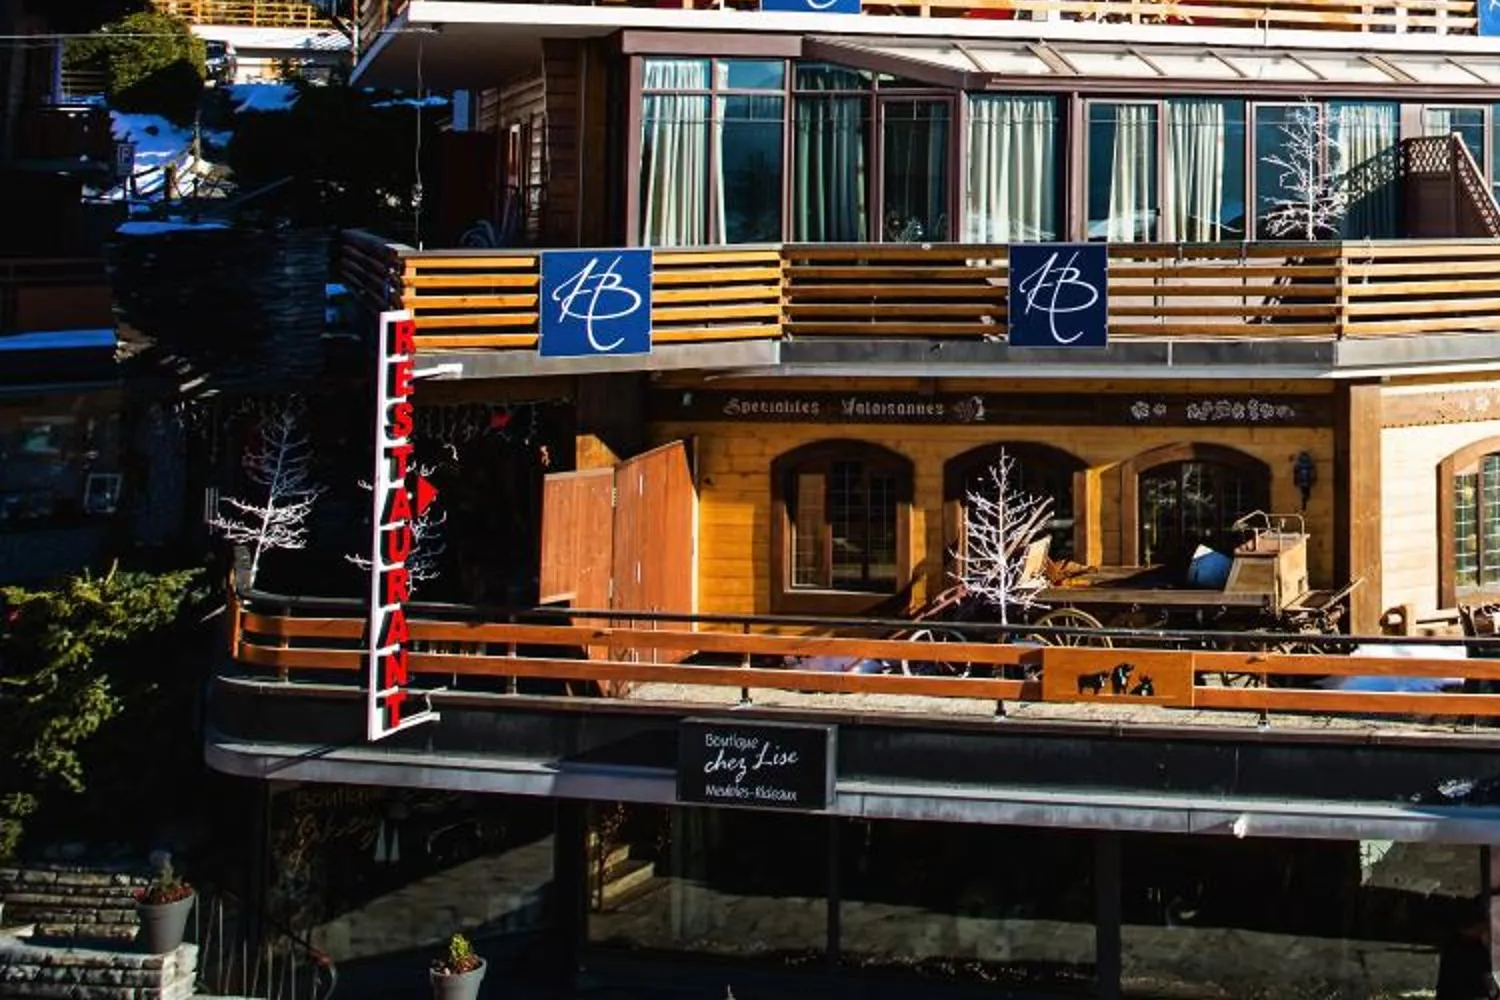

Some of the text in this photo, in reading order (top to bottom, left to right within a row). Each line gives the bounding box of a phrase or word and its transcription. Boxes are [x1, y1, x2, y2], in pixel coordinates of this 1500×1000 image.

[384, 319, 417, 728] RESTAURANT
[703, 741, 800, 783] chez Lise
[704, 732, 759, 750] Boutique
